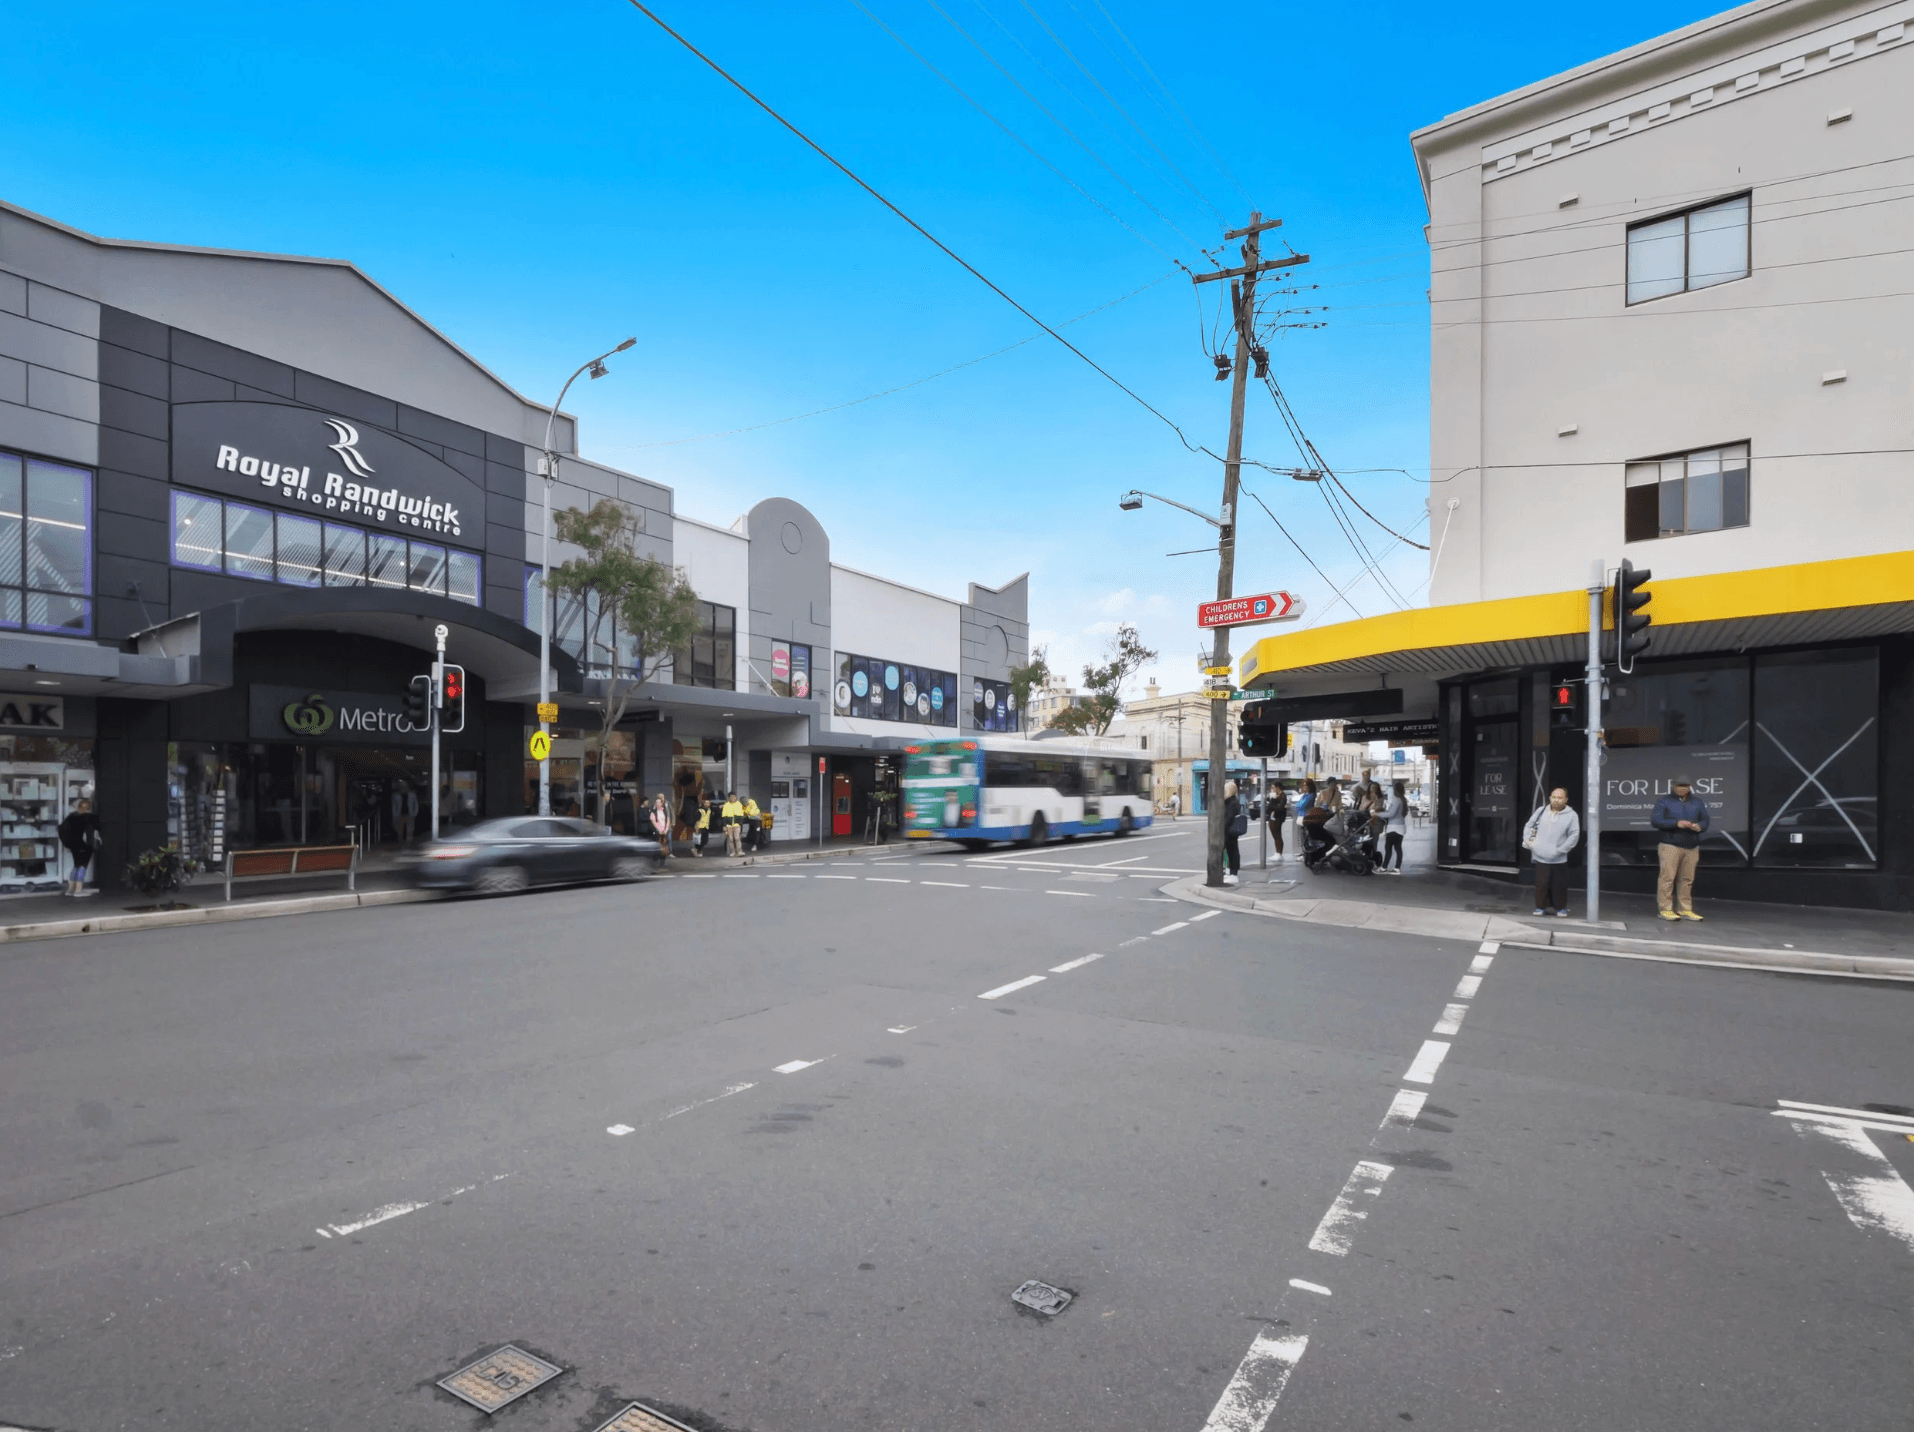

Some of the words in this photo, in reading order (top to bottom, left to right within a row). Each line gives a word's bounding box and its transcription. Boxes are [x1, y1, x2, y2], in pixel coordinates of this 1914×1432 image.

[216, 444, 310, 488] Royal
[323, 472, 460, 526] Randwick
[282, 486, 387, 522] shopping
[398, 512, 462, 537] centre
[1204, 610, 1250, 624] EMERGENCY
[1240, 690, 1265, 700] ARTHUR
[1267, 689, 1275, 697] ST
[1403, 723, 1440, 731] ARTISTR
[1484, 773, 1502, 783] FOR
[1480, 785, 1507, 795] LEASE
[1607, 780, 1649, 795] FOR
[1654, 778, 1724, 795] LESE
